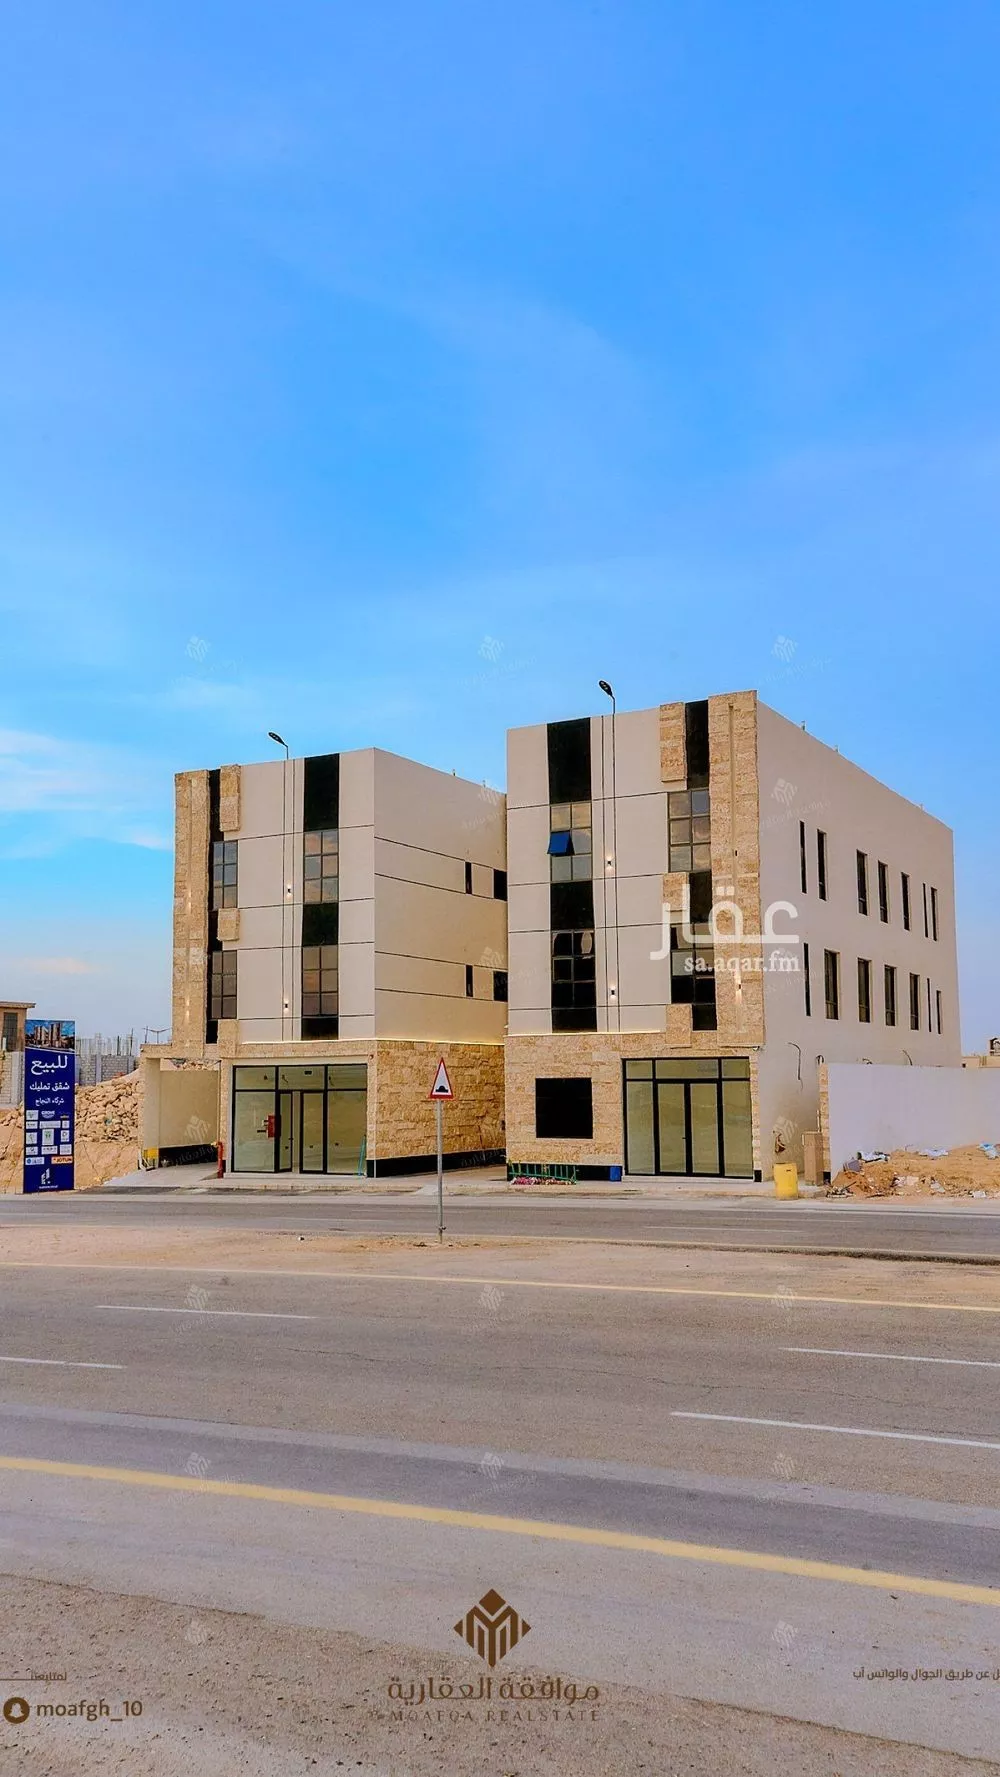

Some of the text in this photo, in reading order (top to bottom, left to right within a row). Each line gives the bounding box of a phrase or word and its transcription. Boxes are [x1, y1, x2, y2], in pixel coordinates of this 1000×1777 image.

[31, 1055, 68, 1075] للبيع
[30, 1081, 70, 1091] شقق تمليك
